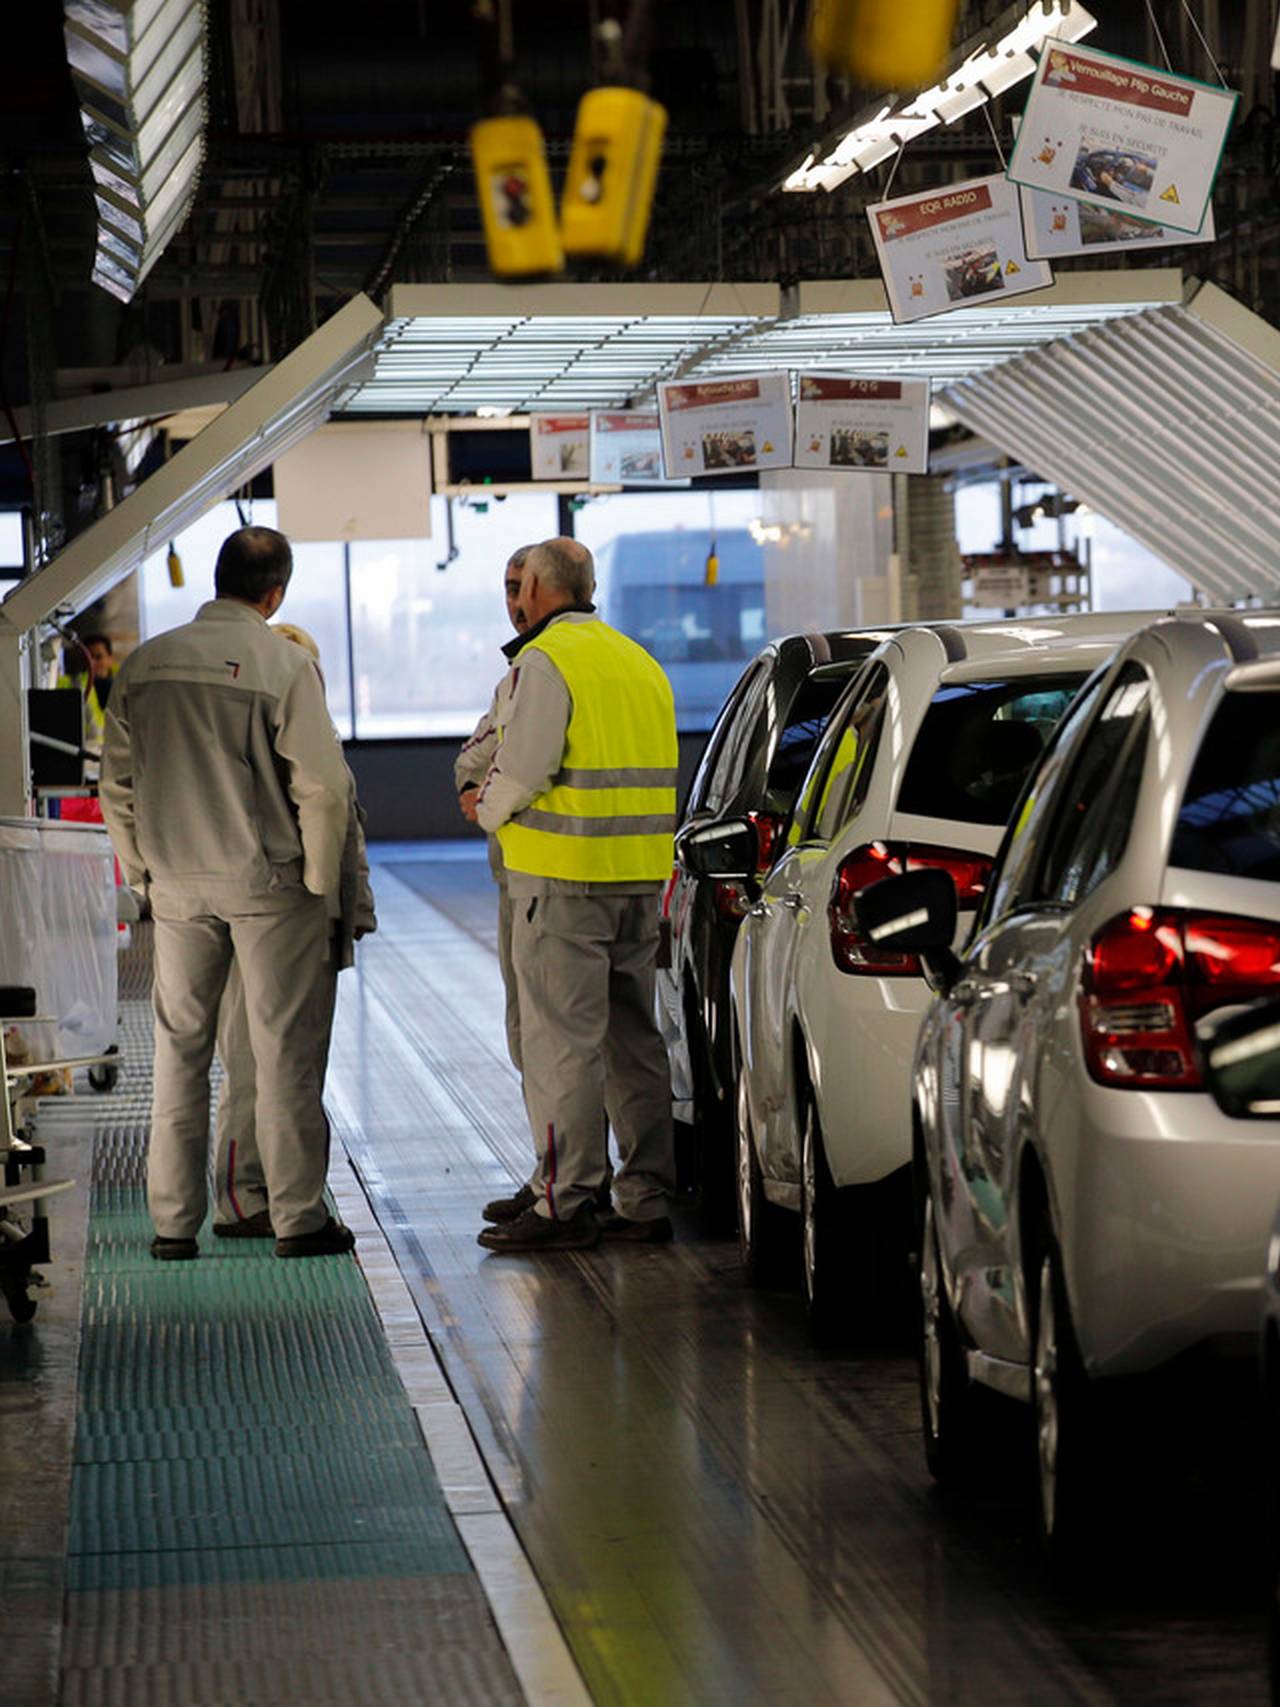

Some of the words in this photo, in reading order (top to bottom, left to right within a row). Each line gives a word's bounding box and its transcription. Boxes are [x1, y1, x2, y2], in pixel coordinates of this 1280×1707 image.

[1071, 60, 1129, 87] Verrouillage
[1151, 84, 1190, 105] Gauche
[920, 200, 942, 215] EQR
[943, 191, 977, 208] RADIO
